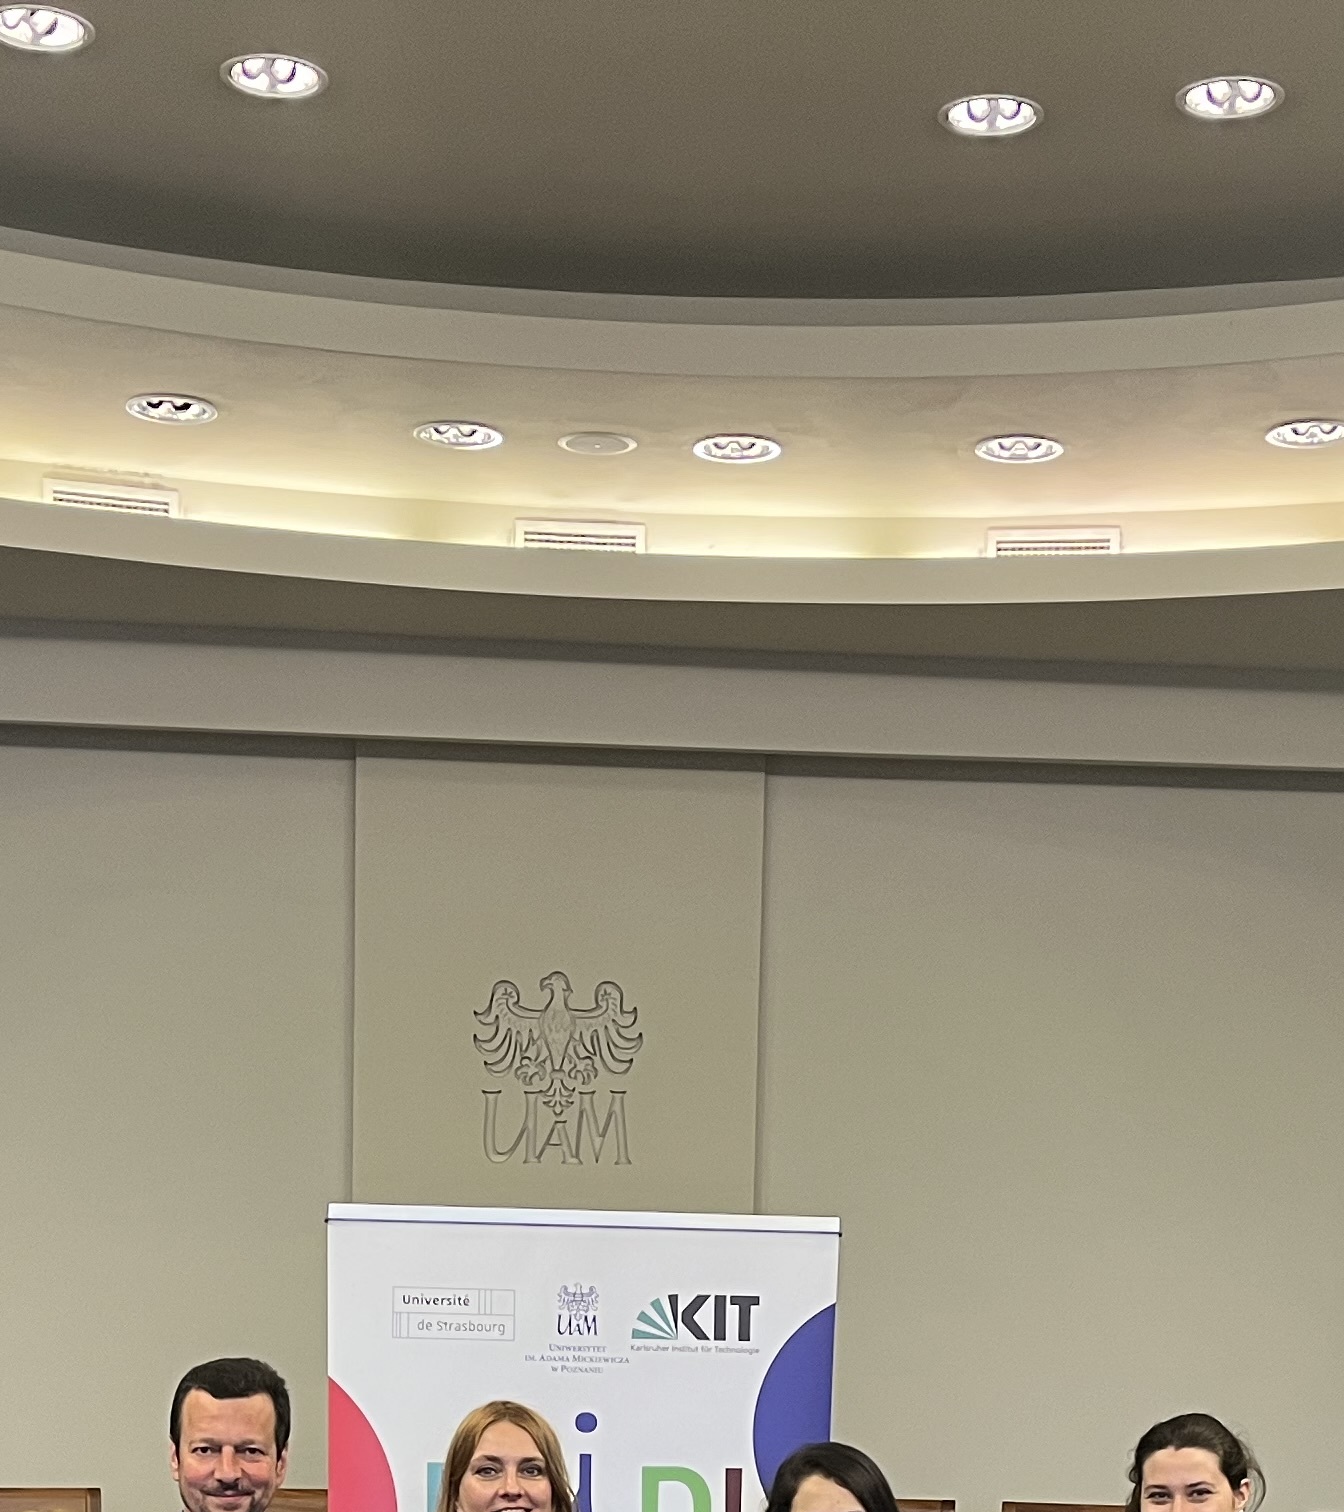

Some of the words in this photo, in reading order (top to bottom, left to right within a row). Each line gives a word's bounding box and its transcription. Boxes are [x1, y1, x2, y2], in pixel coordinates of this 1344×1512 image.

[482, 1089, 632, 1166] UAM
[402, 1293, 470, 1307] Université
[417, 1319, 433, 1332] de
[436, 1320, 506, 1336] Strasbourg
[668, 1293, 760, 1342] KIT
